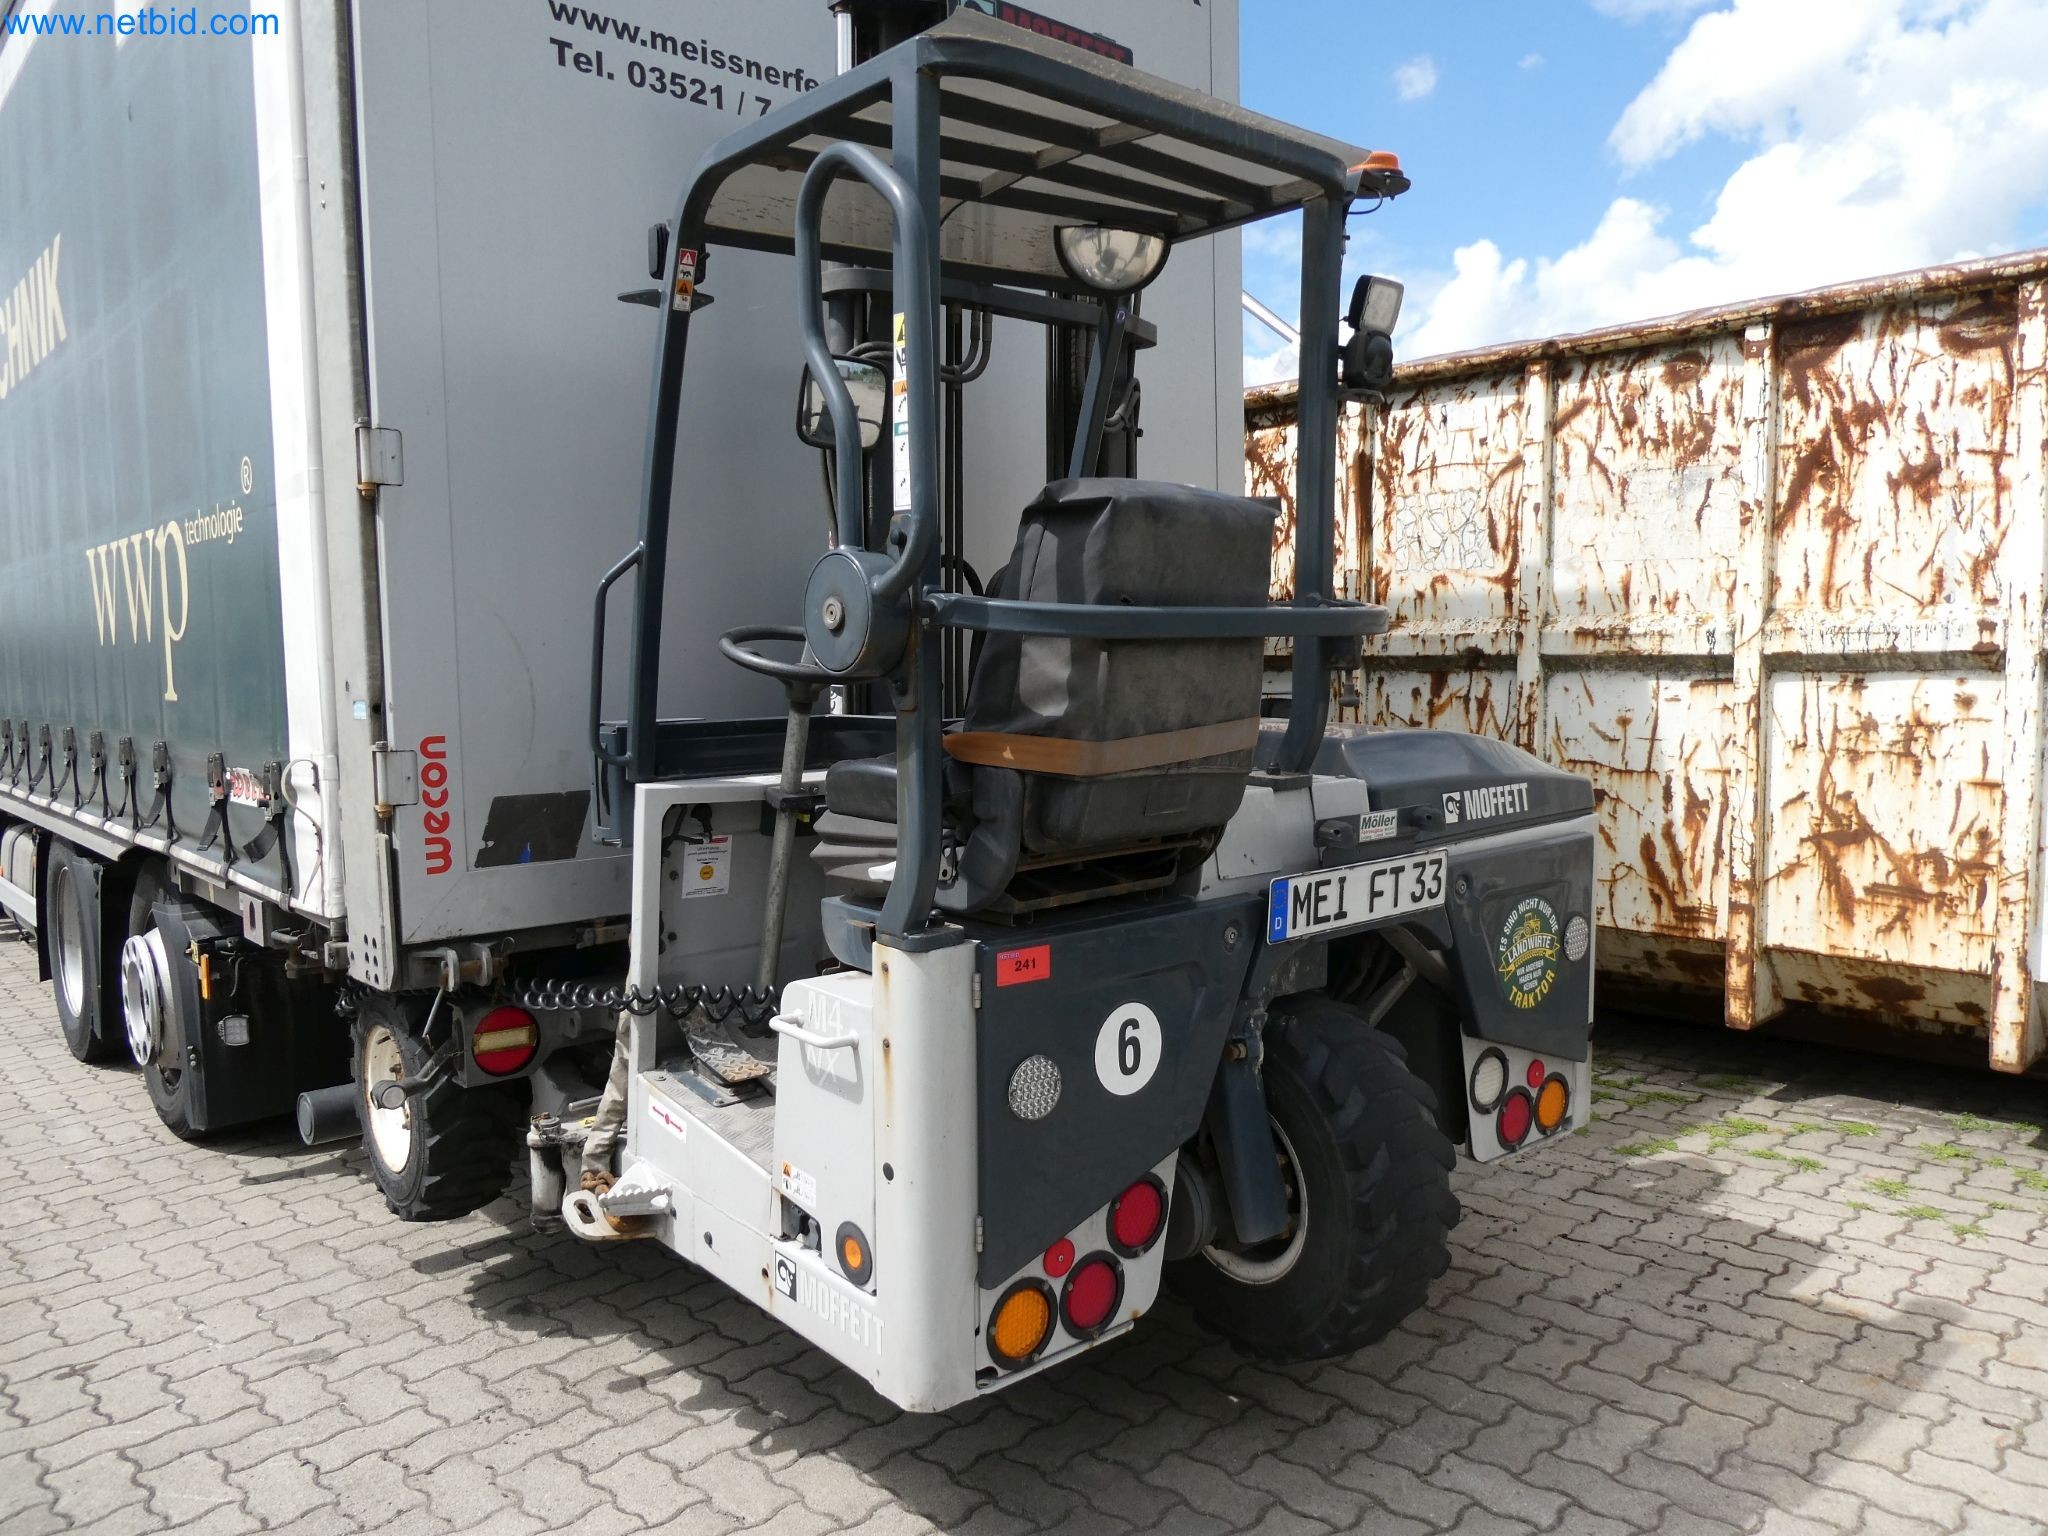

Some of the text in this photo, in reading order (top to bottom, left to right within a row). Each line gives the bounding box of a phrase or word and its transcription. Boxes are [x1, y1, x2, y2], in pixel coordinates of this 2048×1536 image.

[550, 36, 615, 81] Tel.
[628, 60, 724, 111] 03521
[737, 91, 745, 116] /
[86, 520, 189, 702] wwp
[185, 499, 243, 545] technologie
[420, 735, 453, 875] wecon
[1361, 814, 1396, 830] Möller
[1464, 783, 1528, 821] MOFFETT
[1275, 917, 1282, 930] D
[1292, 876, 1348, 930] MEI
[1499, 898, 1559, 951] ES SIND NICHT NUR DIE
[1014, 957, 1036, 972] 241
[1507, 935, 1552, 963] LANDWIRTE
[1510, 969, 1555, 1009] TRAKTOR
[1118, 1017, 1141, 1076] 6
[800, 1268, 885, 1356] MOFFETT
